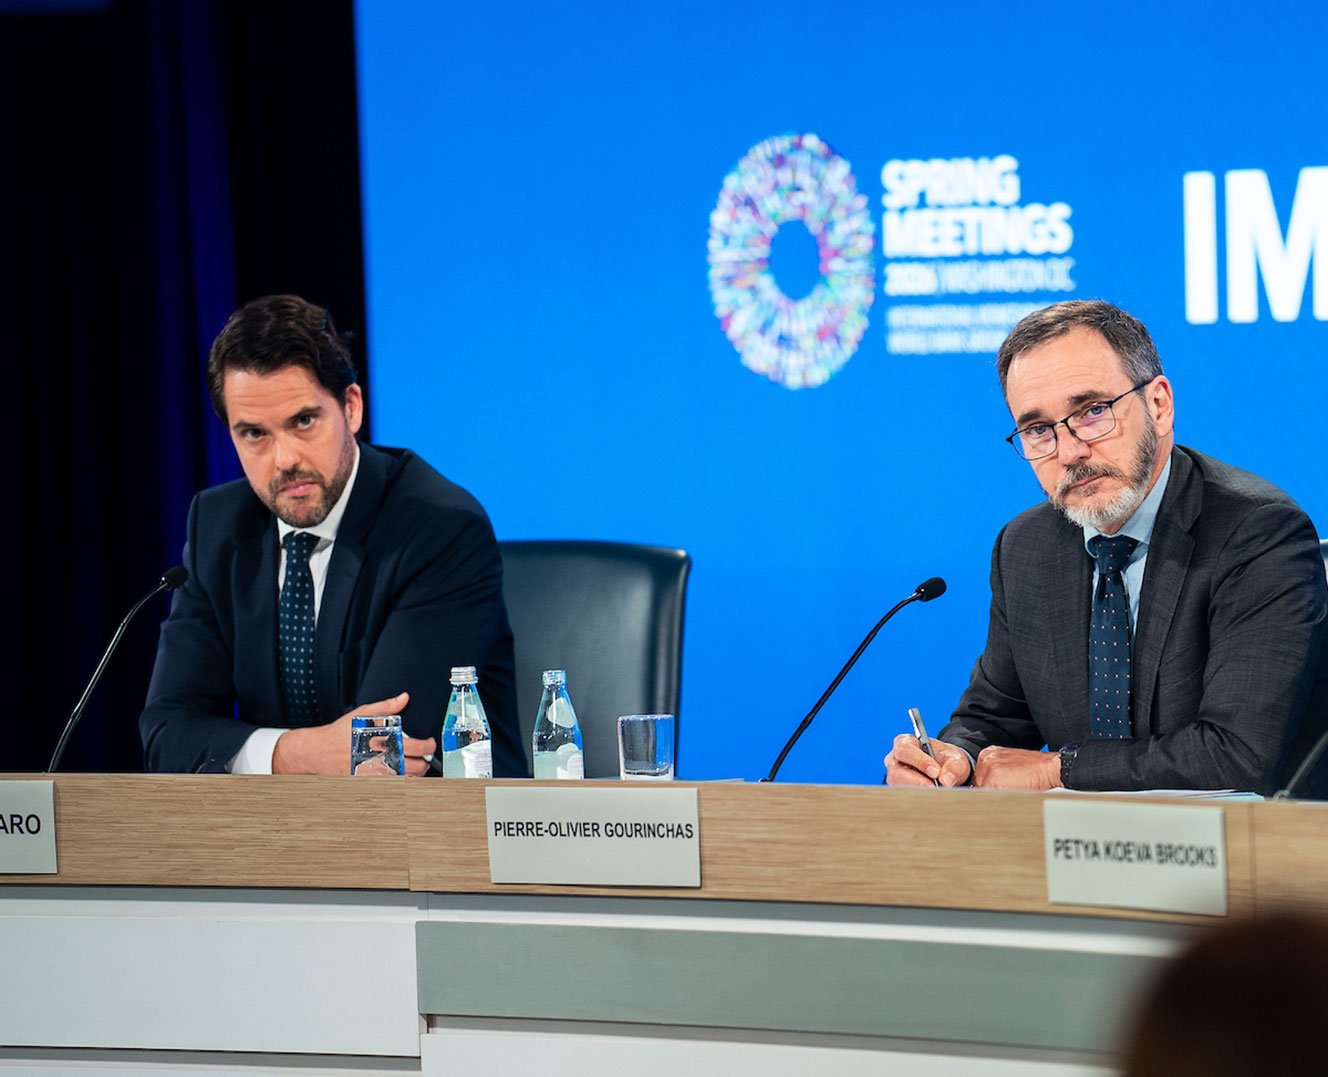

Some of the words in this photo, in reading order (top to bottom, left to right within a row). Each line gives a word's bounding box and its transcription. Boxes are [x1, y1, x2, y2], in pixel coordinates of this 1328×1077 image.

[881, 155, 1021, 208] SPRING
[883, 202, 1074, 259] MEETINGS
[0, 813, 41, 835] ARO
[494, 821, 600, 837] PIERRE-OLIVIER
[604, 822, 694, 839] GOURINCHAS
[1054, 838, 1101, 861] PETYA
[1103, 840, 1152, 863] KOEVA
[1155, 843, 1218, 868] BROOKS
